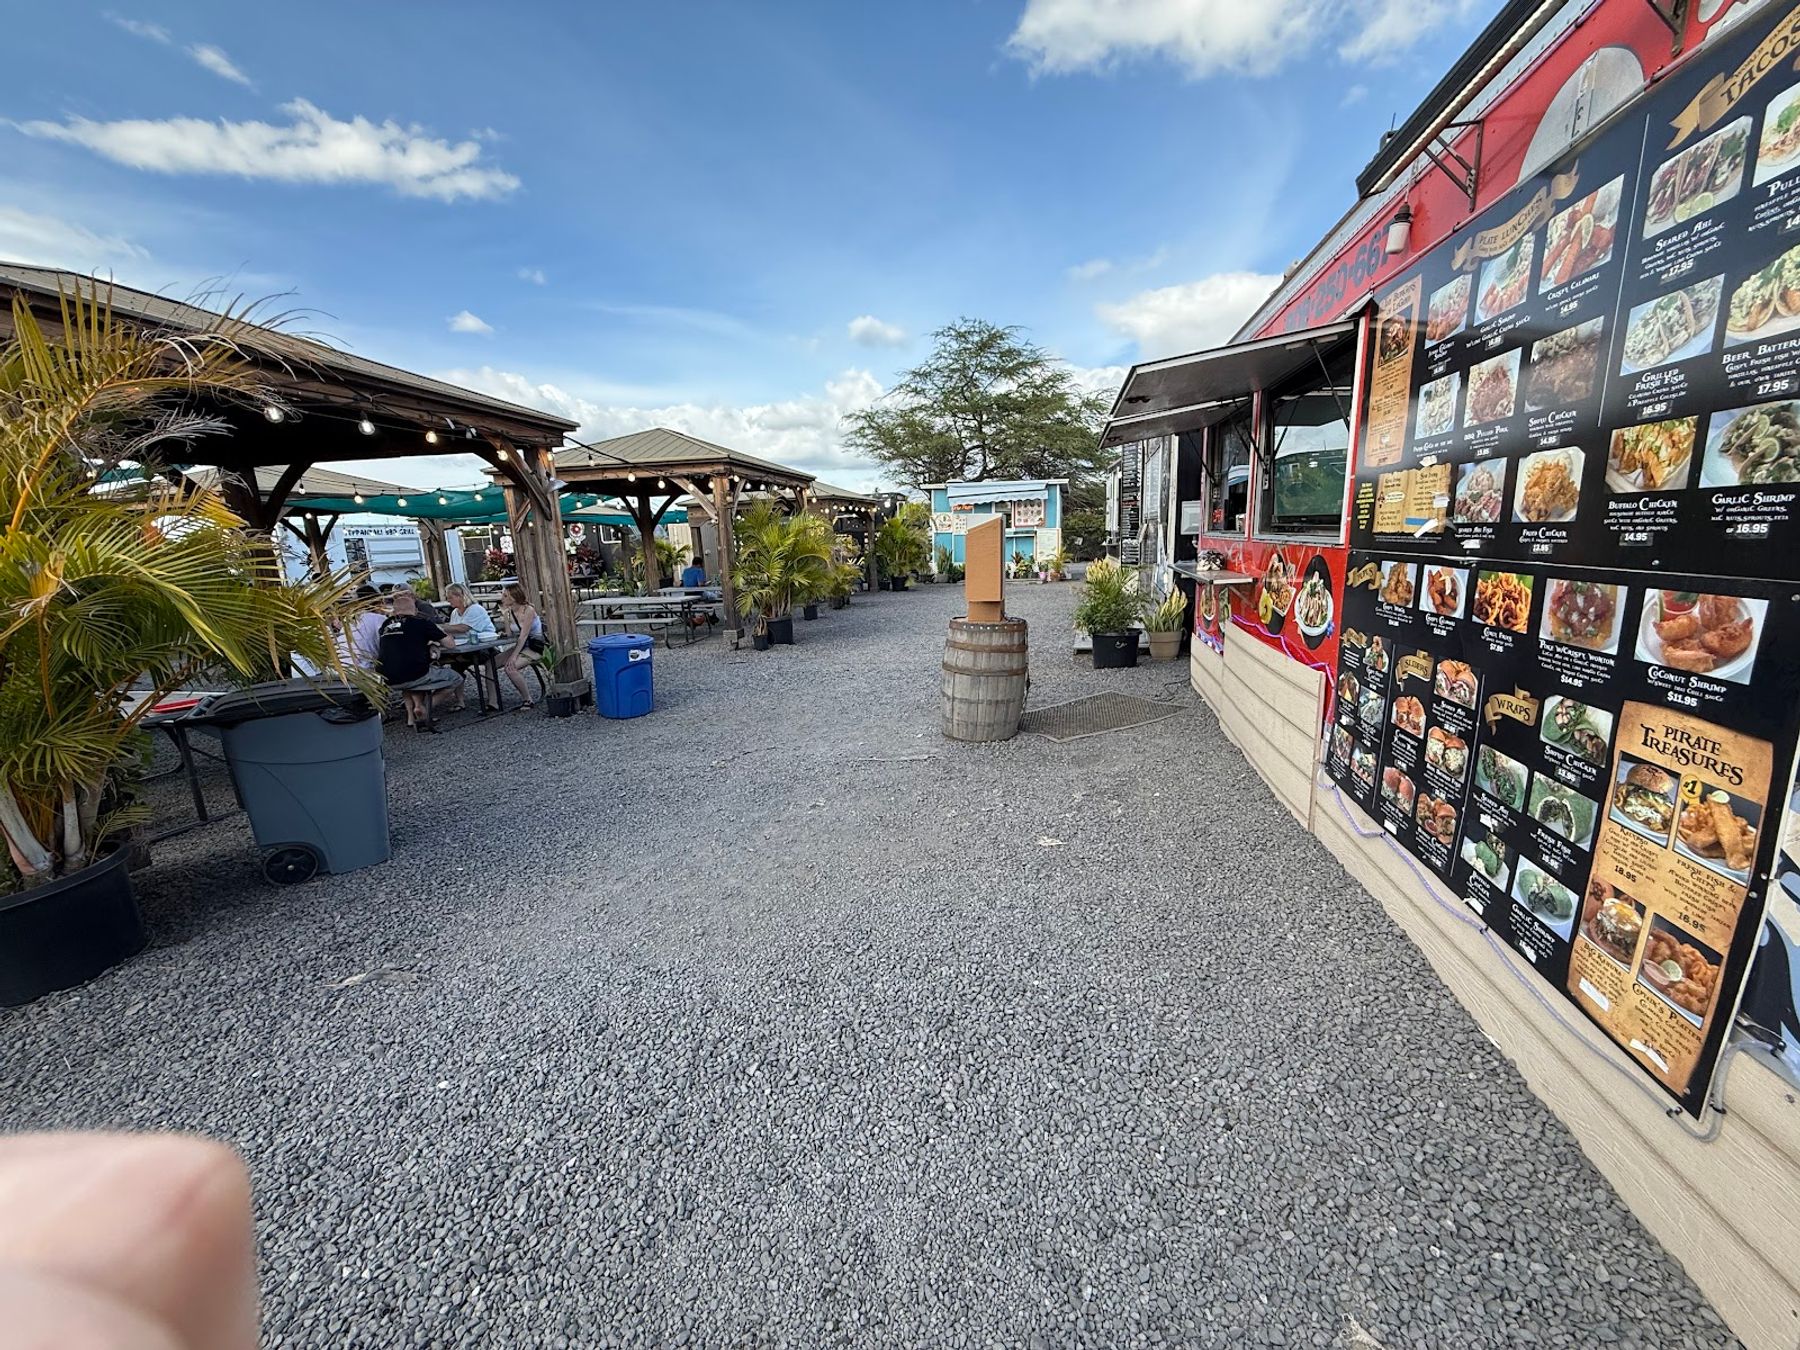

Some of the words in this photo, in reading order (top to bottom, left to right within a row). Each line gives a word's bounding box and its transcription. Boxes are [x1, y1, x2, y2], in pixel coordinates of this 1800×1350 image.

[1655, 230, 1688, 252] SEARED
[1690, 219, 1712, 236] AHI
[1721, 351, 1752, 365] BEER
[1634, 380, 1662, 392] FRESH
[1663, 374, 1686, 385] FISH
[1642, 368, 1679, 382] GRILLED
[1757, 379, 1790, 395] 17.95
[1548, 410, 1577, 424] CHICKEN
[1608, 500, 1638, 510] BUFFALO
[1639, 498, 1678, 510] CHICKEN
[1711, 493, 1750, 504] GARLIC
[1752, 492, 1796, 505] SHRIMP
[1538, 526, 1568, 538] CHICKEN
[1624, 532, 1649, 541] 14.95
[1736, 523, 1768, 534] 16.95
[1560, 674, 1583, 688] $14.95
[1648, 666, 1686, 683] COCONUT
[1688, 676, 1727, 693] SHRIMP
[1667, 691, 1698, 707] $11.95
[1494, 696, 1530, 720] WRAPS
[1662, 724, 1722, 756] PIRATE
[1640, 723, 1744, 786] TREASURES
[1566, 754, 1597, 776] CHICKEN
[1683, 780, 1698, 794] #1
[1614, 865, 1636, 883] 18.95
[1677, 858, 1702, 876] FRESH
[1706, 874, 1725, 888] FISH
[1690, 871, 1716, 891] CHIPS
